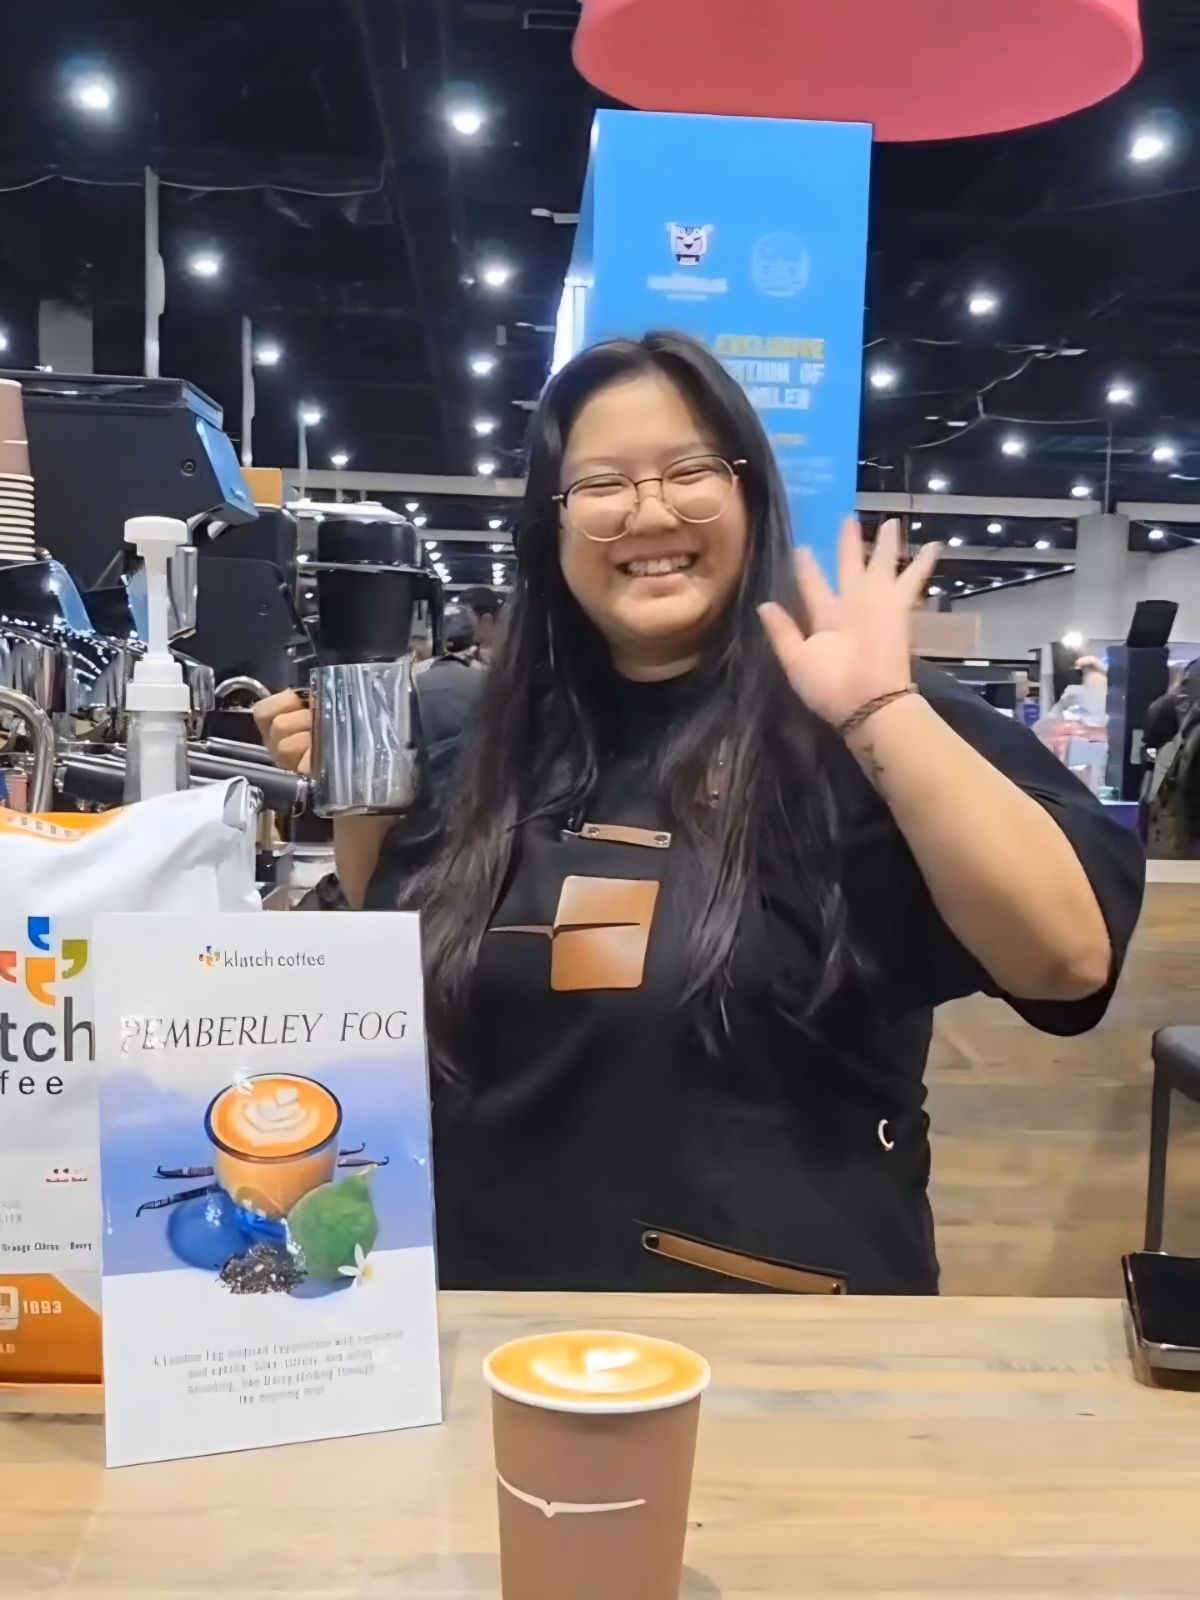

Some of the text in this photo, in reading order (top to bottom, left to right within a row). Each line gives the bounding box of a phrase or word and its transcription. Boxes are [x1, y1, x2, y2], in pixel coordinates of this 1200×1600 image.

[277, 951, 325, 968] coffee
[121, 1010, 408, 1052] PEMBERLEY FOG
